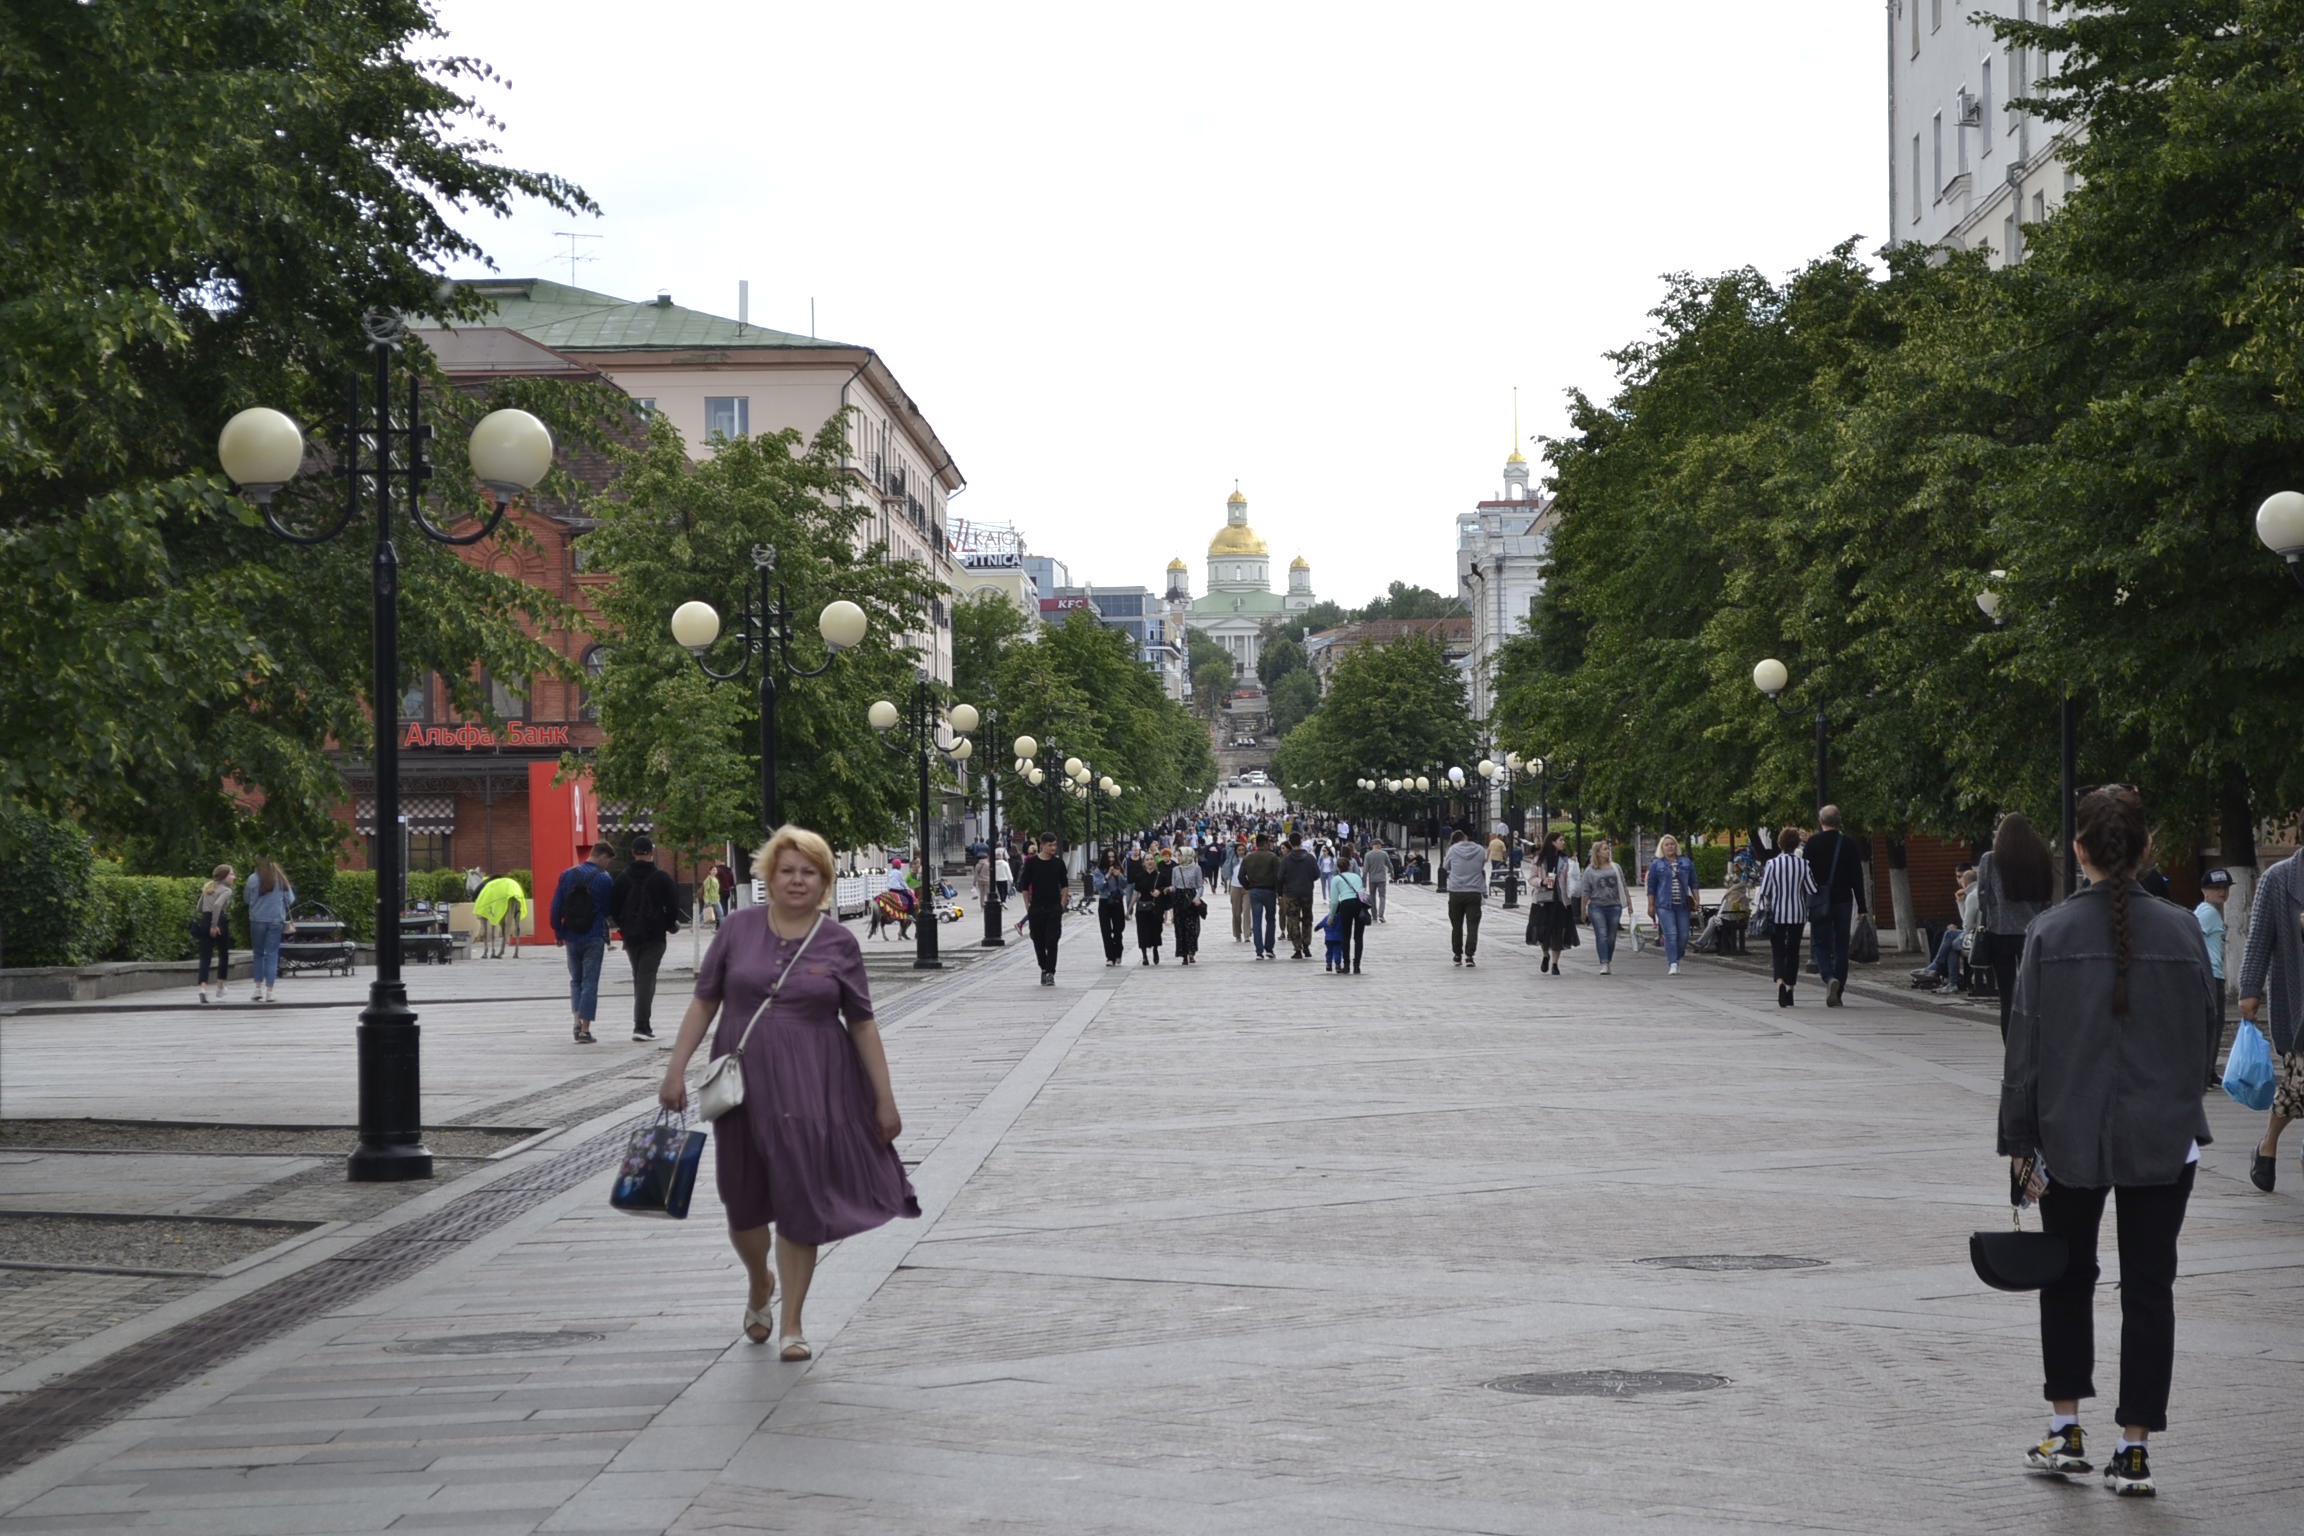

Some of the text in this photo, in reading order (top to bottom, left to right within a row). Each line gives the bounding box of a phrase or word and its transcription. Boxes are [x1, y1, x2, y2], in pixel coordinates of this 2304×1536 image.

[964, 554, 1021, 567] PITNICA
[1057, 599, 1084, 609] KFC
[404, 720, 569, 750] Альфа Банк
